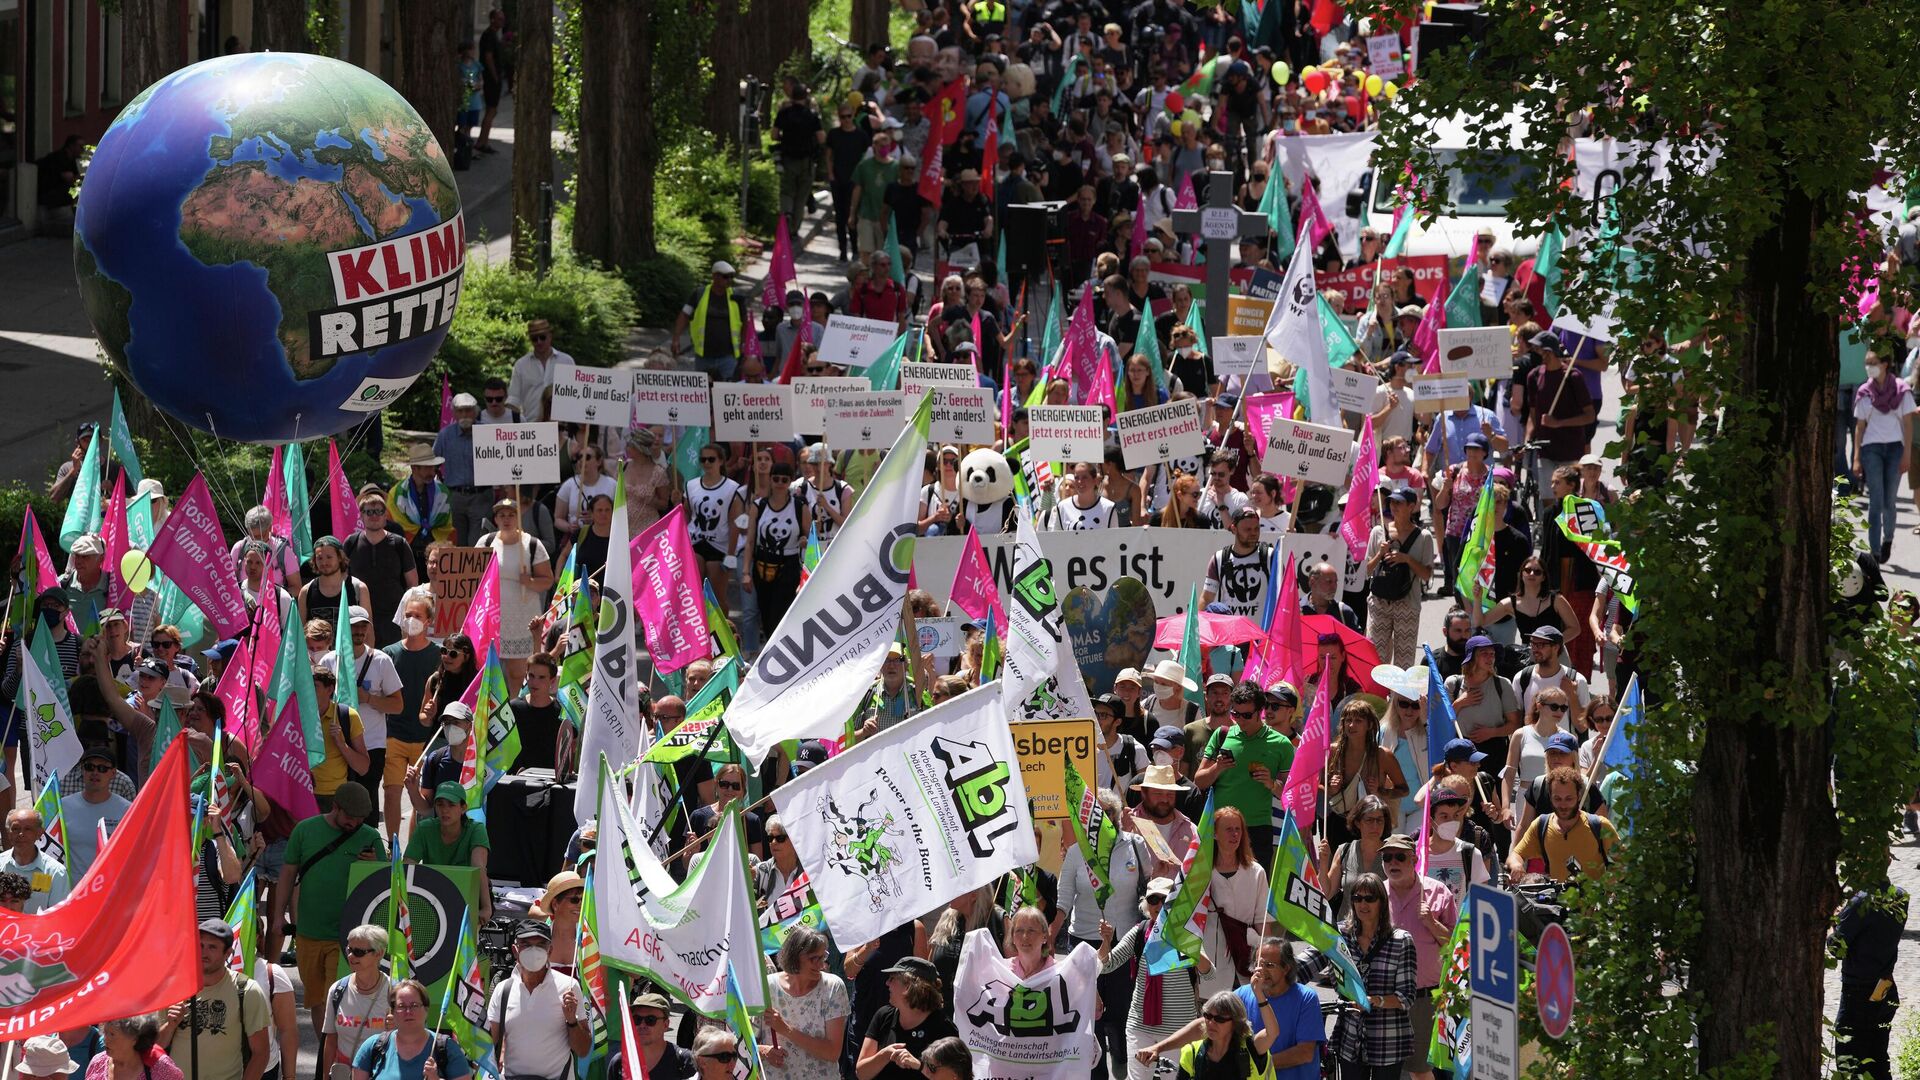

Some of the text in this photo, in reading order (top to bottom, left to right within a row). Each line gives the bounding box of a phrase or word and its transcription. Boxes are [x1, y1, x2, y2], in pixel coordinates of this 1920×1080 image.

[1204, 221, 1235, 231] AGENDA
[1236, 306, 1265, 317] HUNGER
[830, 320, 894, 336] Weltnaturabkommen
[850, 333, 868, 343] jetzt!
[1473, 358, 1498, 369] ALLE
[575, 369, 612, 385] Raus aus
[636, 373, 707, 388] ENERGIEWENDE:
[903, 366, 975, 381] ENERGIEWENDE:
[554, 383, 629, 402] Kohle, Öl und Gas!
[637, 388, 708, 404] jetzt erst recht!
[794, 383, 809, 395] G7:
[724, 393, 780, 406] G7: Gerecht
[839, 398, 852, 408] Raus
[854, 400, 864, 408] aus
[866, 398, 876, 407] den
[949, 393, 984, 407] Gerecht
[723, 408, 783, 423] geht anders!
[859, 409, 868, 418] die
[869, 408, 894, 418] Zukunft!
[930, 408, 986, 424] geht anders!
[1031, 409, 1100, 424] ENERGIEWENDE:
[1119, 403, 1196, 430] ENERGIEWENDE:
[495, 428, 536, 441] Raus aus
[1031, 426, 1101, 440] jetzt erst recht!
[1122, 419, 1198, 448] jetzt erst recht!
[1292, 425, 1331, 444] Raus aus
[475, 442, 557, 460] Kohle, Öl und Gas!
[1268, 436, 1347, 463] Kohle, Öl und Gas!
[181, 497, 218, 543] Fossile
[1067, 557, 1108, 592] es
[1119, 543, 1176, 598] ist,
[204, 561, 245, 617] retten!
[654, 529, 710, 647] Fossile stoppen
[640, 554, 667, 599] Klima
[660, 600, 692, 655] retten!
[1075, 648, 1088, 658] FOR
[1077, 652, 1104, 665] FUTURE
[600, 704, 625, 738] EARTH
[918, 749, 959, 833] Arbeitsgemeinschaft
[910, 754, 933, 800] bäuerliche
[930, 800, 957, 858] Landwirtschaft
[875, 767, 933, 891] Power to the Bauer
[1477, 899, 1500, 981] P
[968, 1038, 1007, 1056] bäuerliche
[969, 1028, 1049, 1050] Arbeitsgemeinschaft
